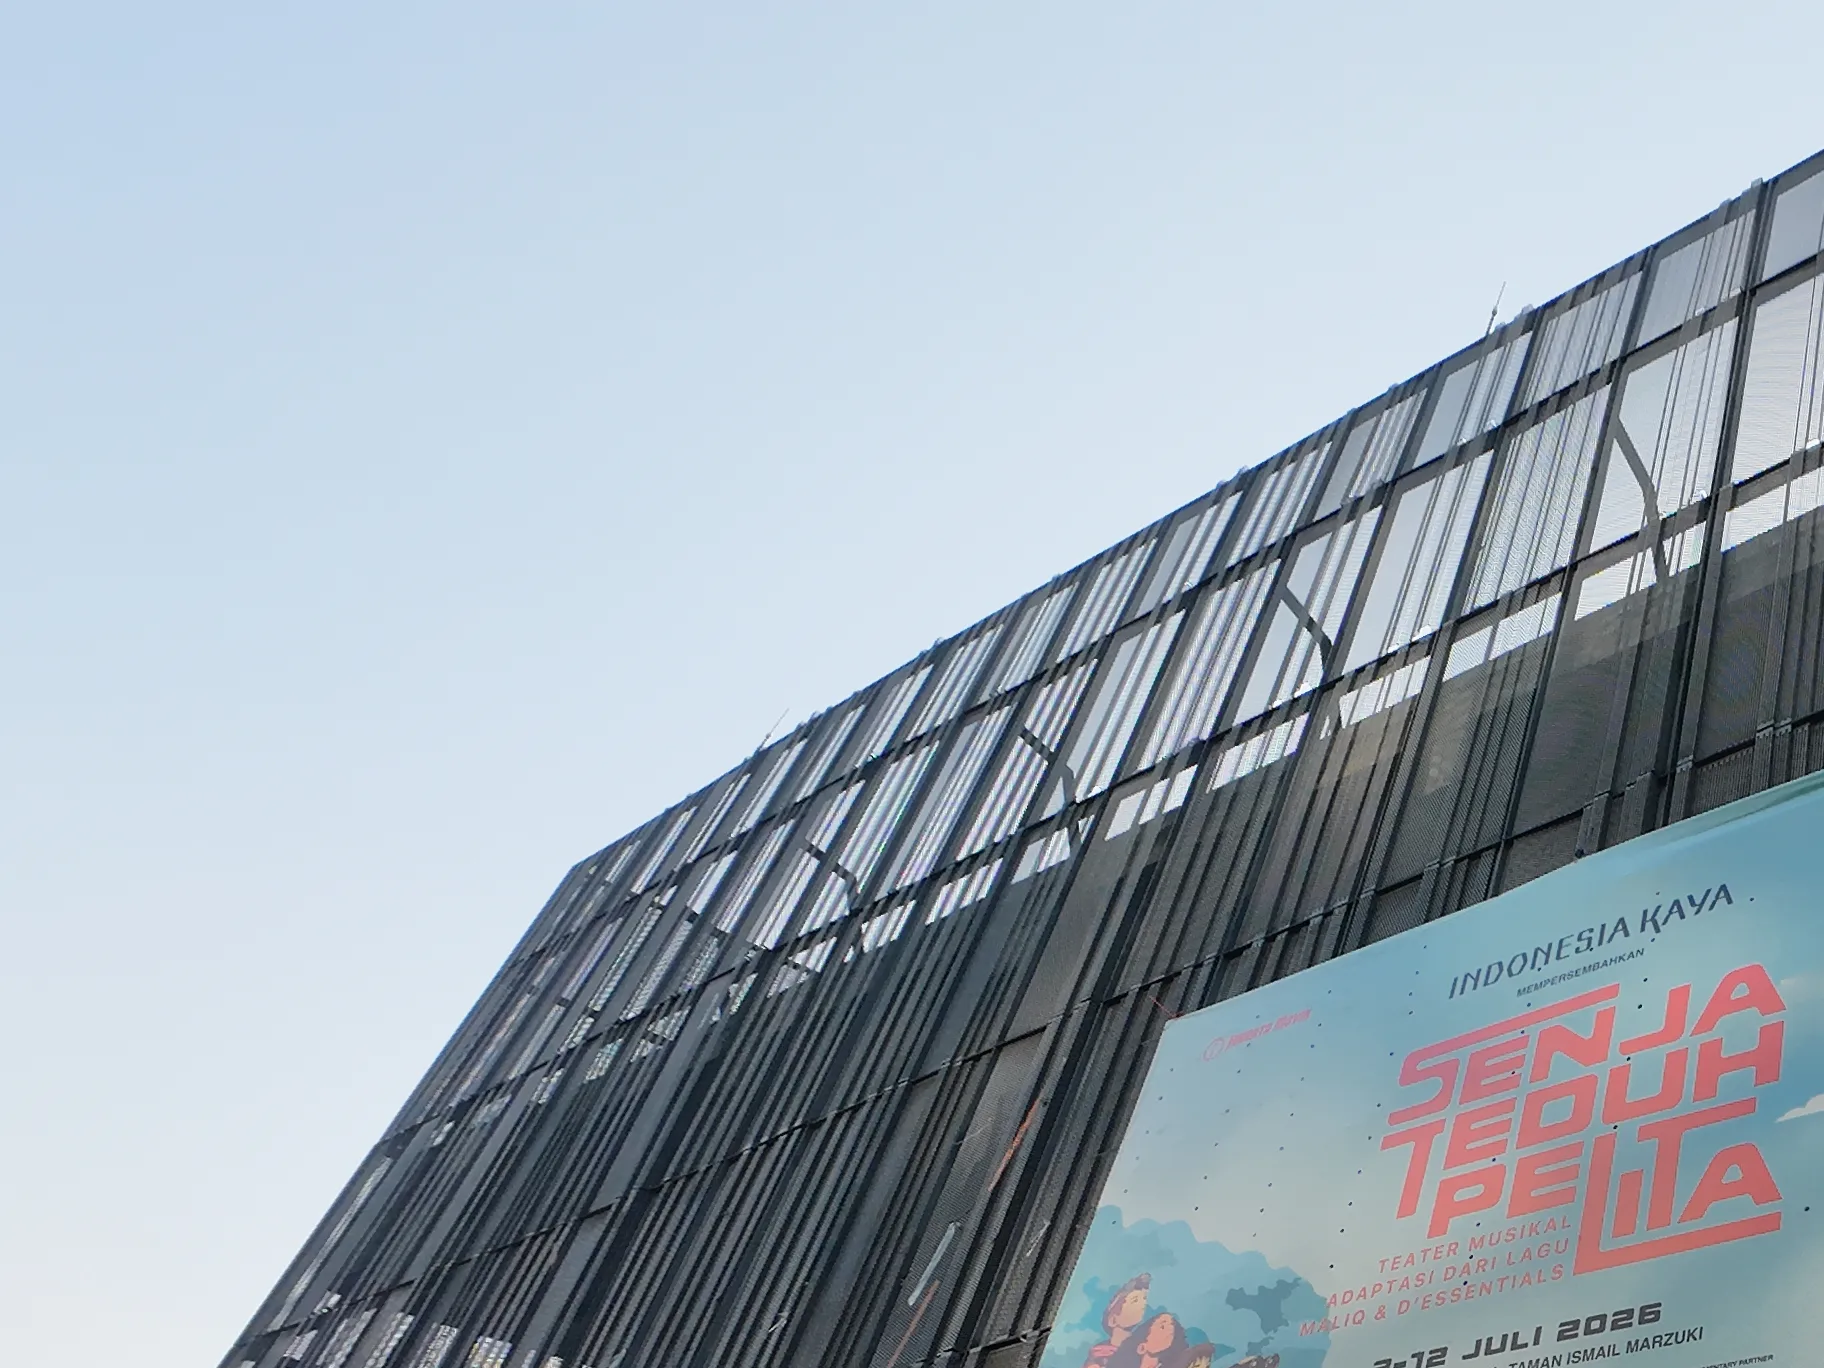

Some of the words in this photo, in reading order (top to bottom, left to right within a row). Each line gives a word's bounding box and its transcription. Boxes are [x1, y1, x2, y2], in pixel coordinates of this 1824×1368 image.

[1449, 916, 1630, 999] INDONESIA
[1640, 884, 1734, 934] KAYA
[1516, 948, 1645, 997] MEMPERSEMBAHKAN
[1387, 963, 1786, 1126] SENJA
[1380, 1020, 1785, 1219] TEDUH
[1426, 1097, 1783, 1276] PELITA
[1326, 1270, 1434, 1308] ADAPTASI
[1444, 1256, 1496, 1281] DARI
[1506, 1238, 1569, 1265] LAGU
[1379, 1241, 1459, 1274] TEATER
[1469, 1215, 1572, 1251] MUSIKAL
[1300, 1309, 1366, 1336] MALIQ
[1374, 1305, 1387, 1320] &
[1397, 1264, 1564, 1316] D'ESSENTIALS
[1462, 1326, 1542, 1360] JULI
[1556, 1302, 1662, 1342] 2026
[1566, 1344, 1620, 1365] ISMAIL
[1626, 1326, 1704, 1354] MARZUKI
[1738, 1354, 1774, 1366] PARTNER
